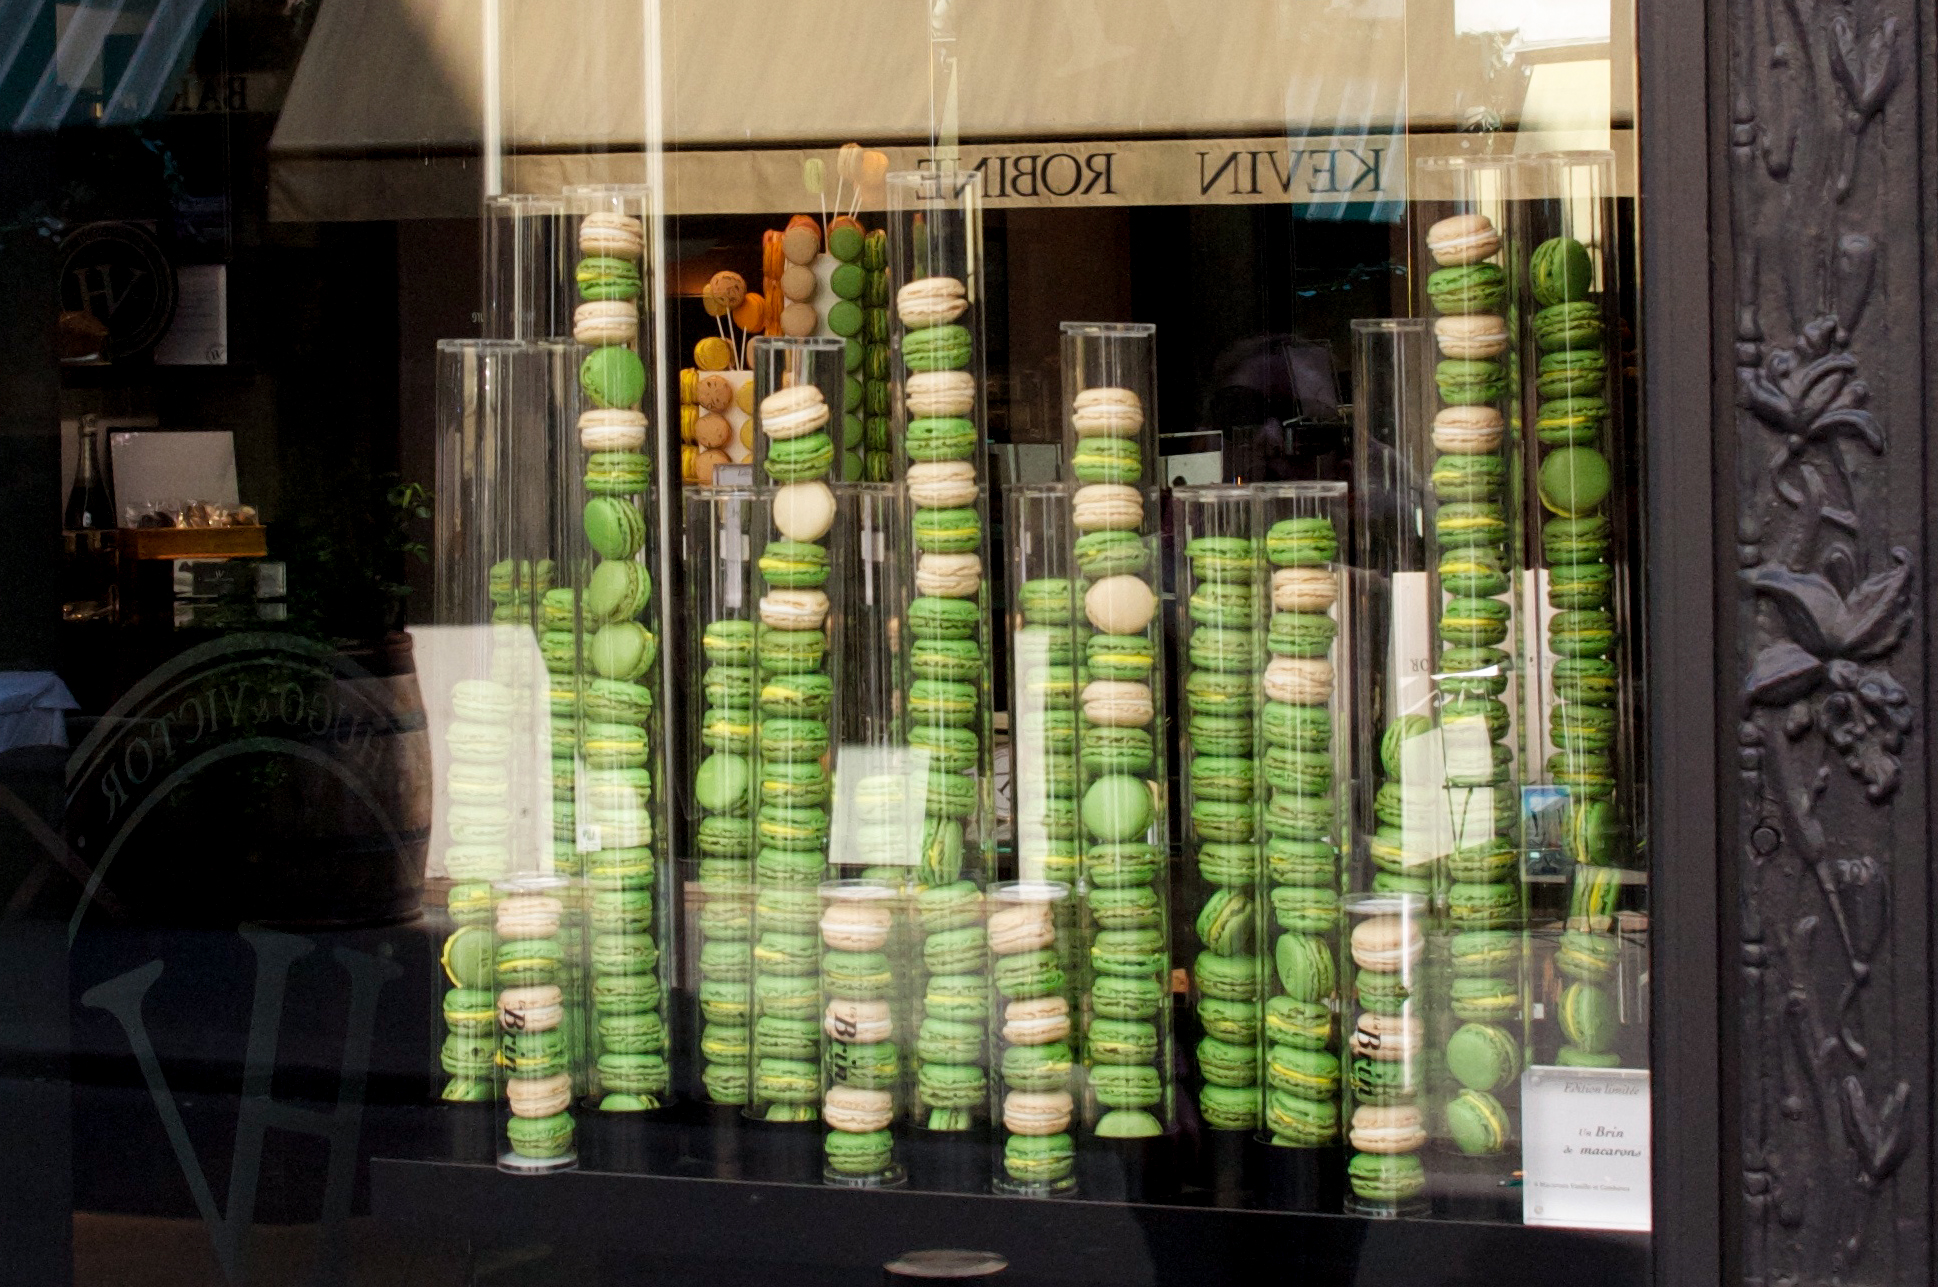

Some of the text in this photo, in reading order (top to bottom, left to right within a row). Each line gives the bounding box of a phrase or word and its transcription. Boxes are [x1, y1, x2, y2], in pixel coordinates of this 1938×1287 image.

[503, 1003, 526, 1073] Brin
[834, 1012, 857, 1081] Brin
[1357, 1025, 1382, 1096] Brin
[1579, 1147, 1642, 1158] macarons
[1595, 1125, 1624, 1139] Brin
